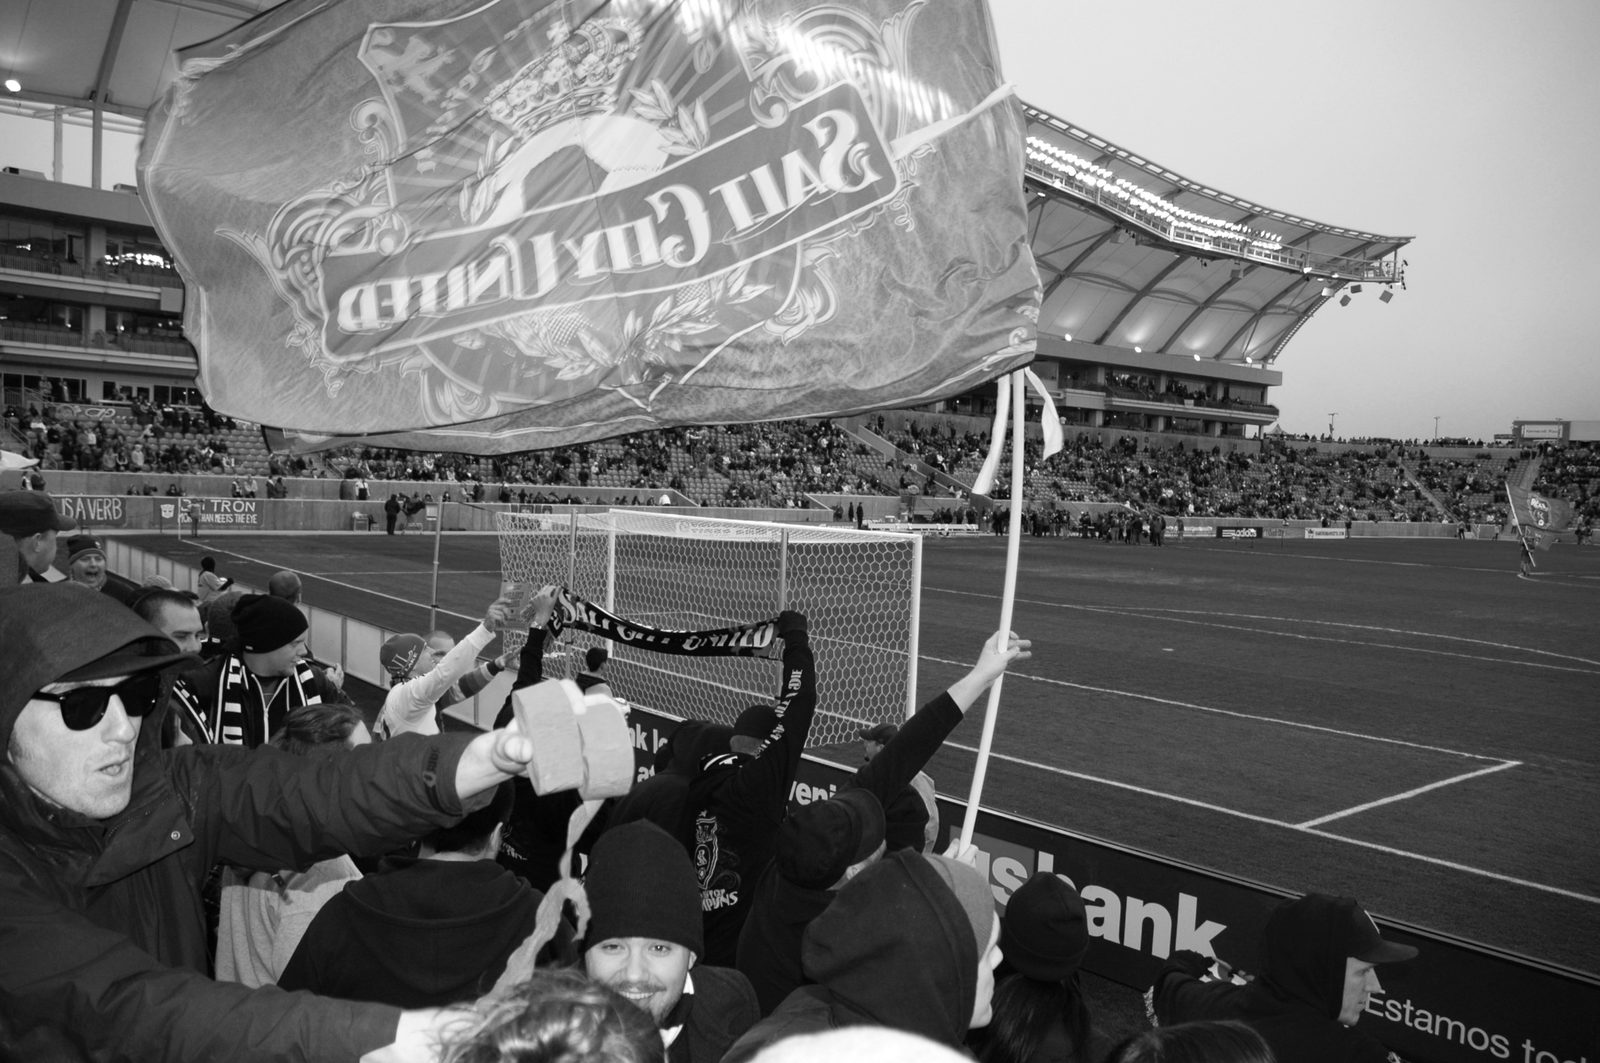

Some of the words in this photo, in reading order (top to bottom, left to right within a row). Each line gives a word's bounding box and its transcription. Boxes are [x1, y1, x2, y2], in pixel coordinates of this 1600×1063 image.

[86, 497, 123, 521] VERB
[214, 513, 234, 524] MEETS
[234, 513, 246, 524] THE
[246, 513, 258, 524] EYE
[1364, 988, 1511, 1060] Estamos
